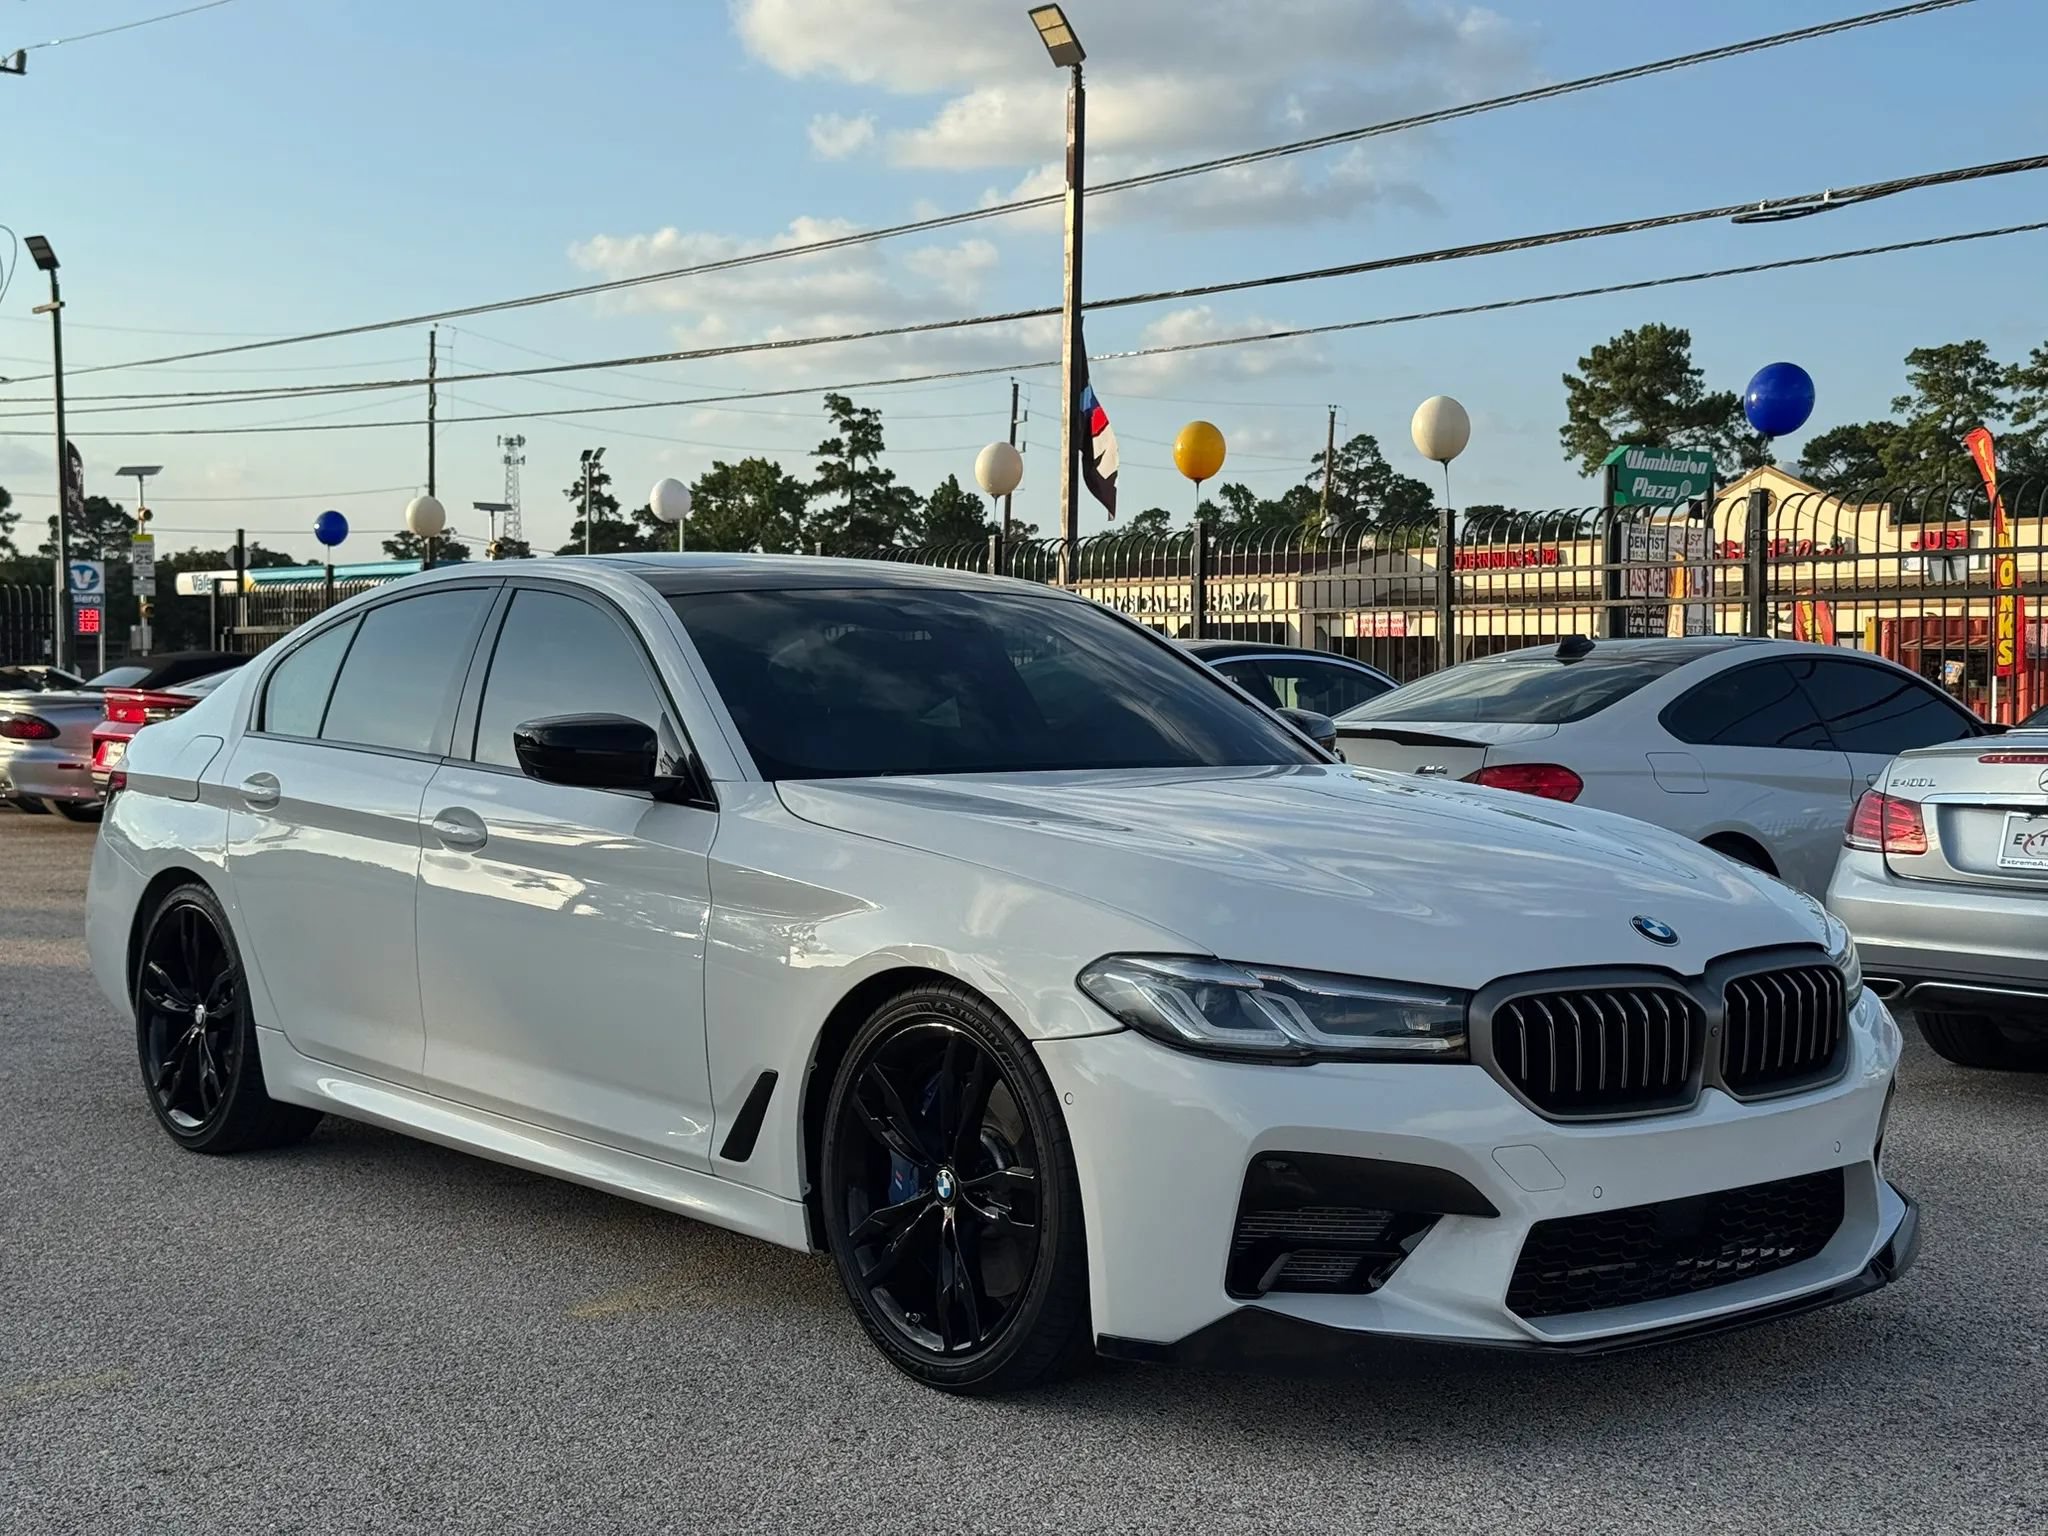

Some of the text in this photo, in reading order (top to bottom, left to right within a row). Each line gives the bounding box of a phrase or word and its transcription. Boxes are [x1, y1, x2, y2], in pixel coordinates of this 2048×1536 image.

[1625, 449, 1708, 474] Wimbledon
[1632, 477, 1677, 499] Plaza
[1629, 535, 1665, 551] DENIST
[1910, 530, 1968, 552] JUST
[136, 554, 153, 566] 25
[1455, 551, 1489, 570] ODERN
[1629, 568, 1664, 593] ASSAGE
[1179, 591, 1257, 613] TRAPY
